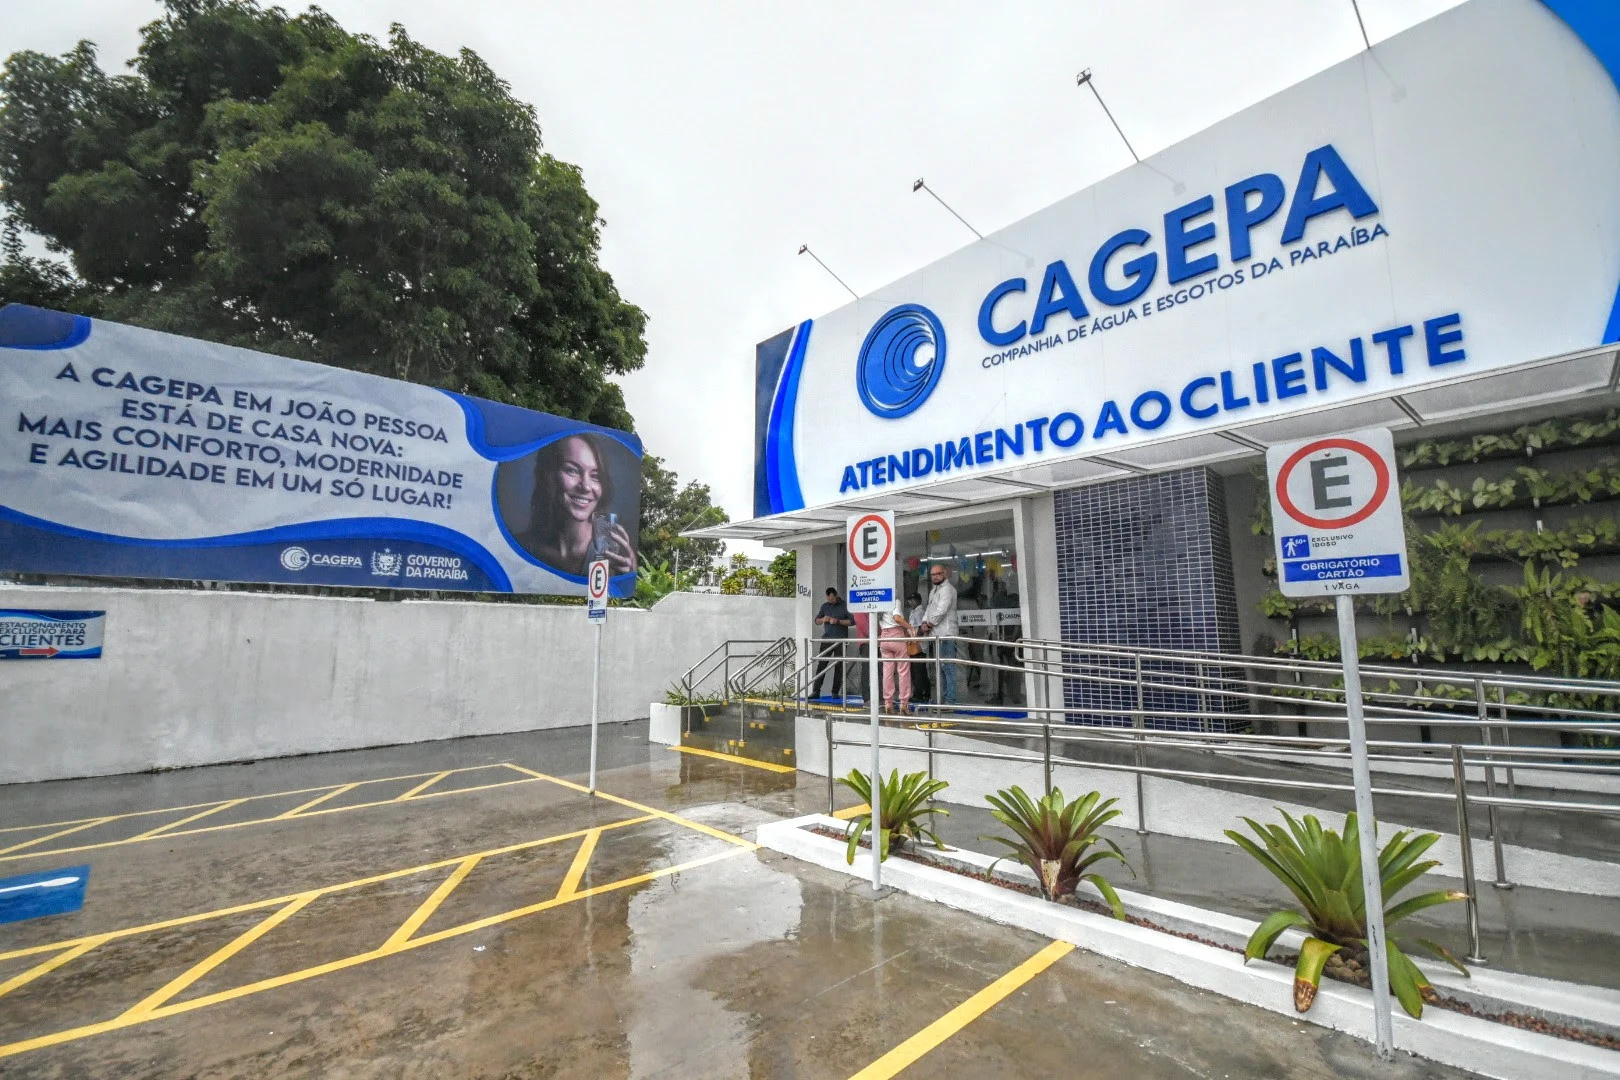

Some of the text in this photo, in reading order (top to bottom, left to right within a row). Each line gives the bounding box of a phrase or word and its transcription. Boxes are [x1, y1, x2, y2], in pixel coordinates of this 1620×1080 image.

[977, 143, 1380, 348] CAGEPA
[981, 222, 1390, 370] COMPANHIA DE ÁGUA E ESGOTOS DA PARAÍBA
[56, 361, 448, 443] A CAGEPA EM JOÃO PESSOA
[838, 312, 1467, 493] ATENDIMENTO AO CLIENTE
[121, 398, 404, 458] ESTÁ DE CASA NOVA:
[18, 412, 463, 489] MAIS CONFORTO, MODERNIDADE
[29, 443, 452, 510] E AGILIDADE EM UM SÓ LUGAR!
[1310, 456, 1352, 510] E
[863, 526, 877, 559] E
[1311, 534, 1353, 543] EXCLUSIVO
[311, 553, 363, 567] CAGEPA
[407, 554, 461, 569] GOVERNO
[1301, 557, 1380, 571] OBRIGATÓRIO
[406, 567, 468, 580] DA PARAÍBA
[595, 570, 601, 590] E
[1317, 569, 1364, 579] CARTÃO
[1331, 583, 1360, 591] VAGA
[0, 635, 84, 646] CLIENTES
